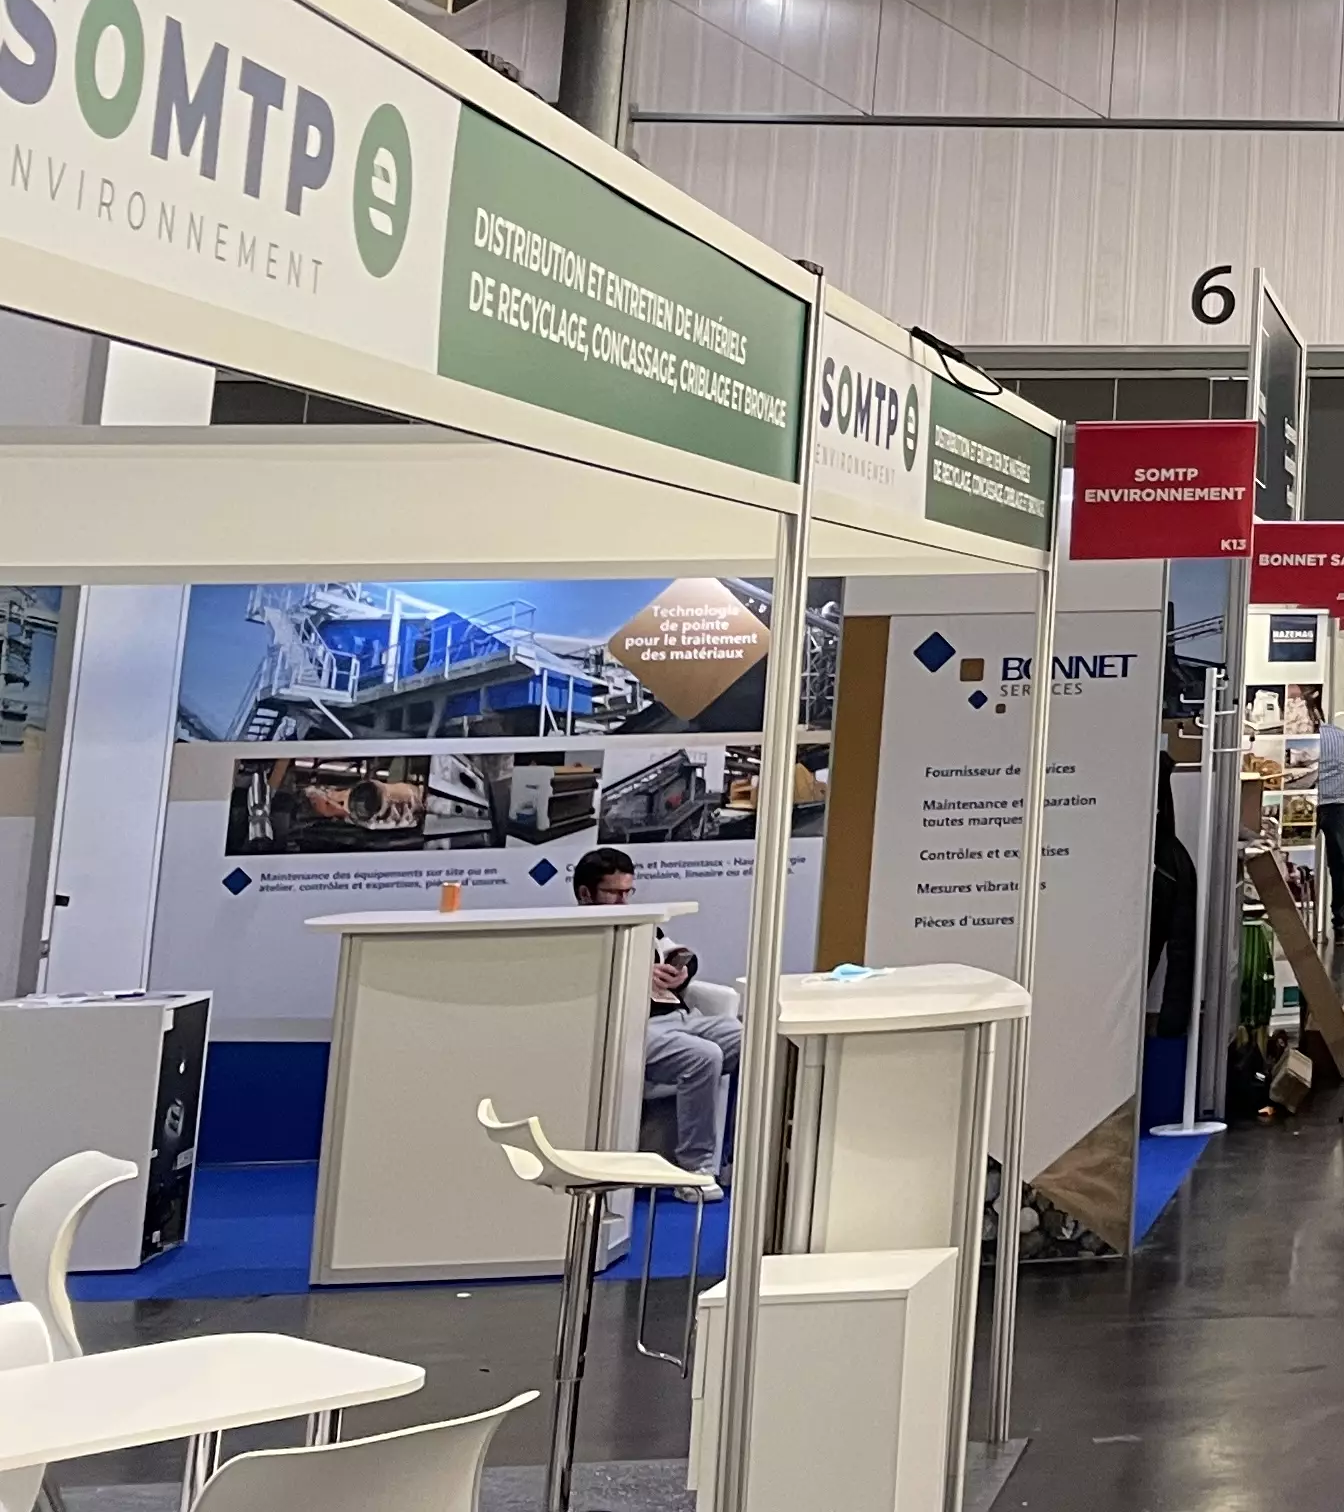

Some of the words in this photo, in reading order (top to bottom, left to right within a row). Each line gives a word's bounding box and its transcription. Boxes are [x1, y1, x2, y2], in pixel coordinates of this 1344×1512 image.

[11, 143, 324, 295] NVIRONNEMENT
[474, 207, 586, 294] DISTRIBUTION
[587, 262, 605, 302] ET
[605, 271, 674, 333] ENTRETIEN
[674, 304, 693, 341] DE
[693, 310, 747, 365] MATÉRIELS
[1192, 265, 1236, 325] 6
[469, 271, 496, 318] DE
[498, 283, 589, 361] RECYCLAGE,
[592, 323, 678, 394] CONCASSAGE,
[680, 359, 731, 409] CRIBLAGE
[731, 380, 745, 412] ET
[745, 385, 787, 428] BROYAGE
[820, 357, 898, 450] SOMTP
[1134, 467, 1199, 483] SOMTP
[1084, 486, 1247, 504] ENVIRONNEMENT
[1220, 538, 1247, 551] K13
[1259, 554, 1327, 567] BONNET
[660, 620, 678, 632] de
[682, 620, 730, 634] pointe
[625, 636, 660, 650] pour
[664, 634, 677, 646] le
[681, 632, 758, 646] traitement
[641, 648, 666, 661] des
[670, 647, 744, 660] matériaux
[1000, 683, 1083, 697] SERCES
[925, 765, 1001, 778] Fournisseur
[1005, 765, 1021, 776] de
[923, 798, 1008, 811] Maintenance
[922, 816, 964, 827] toutes
[920, 848, 983, 861] Contrôles
[987, 848, 1000, 859] et
[1003, 846, 1070, 861] extises
[917, 881, 971, 894] Mesures
[976, 879, 1046, 892] vibrats
[914, 915, 955, 928] Pièces
